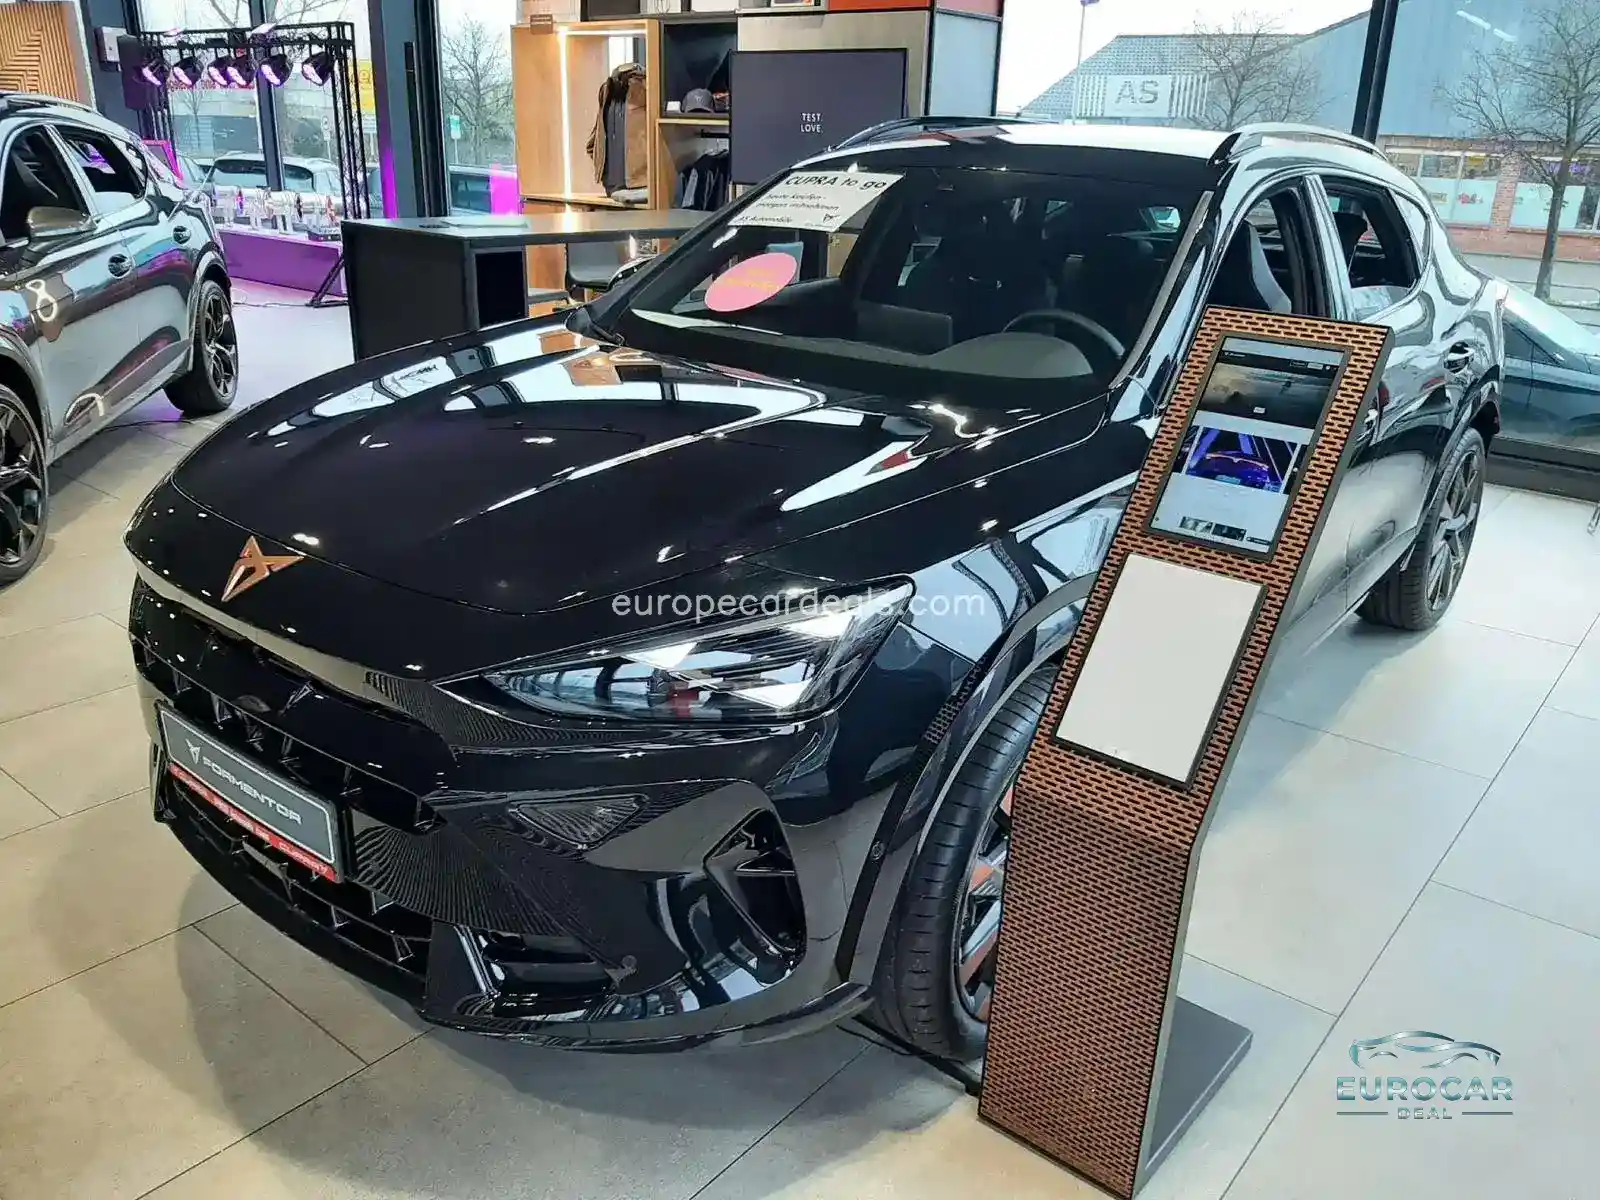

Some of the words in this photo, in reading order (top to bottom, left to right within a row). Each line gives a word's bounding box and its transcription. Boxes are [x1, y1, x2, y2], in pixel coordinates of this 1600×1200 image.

[1115, 80, 1159, 104] AS
[785, 176, 839, 187] CUPRA
[841, 177, 858, 188] to
[859, 180, 887, 191] go
[202, 756, 302, 825] FORMENTOR
